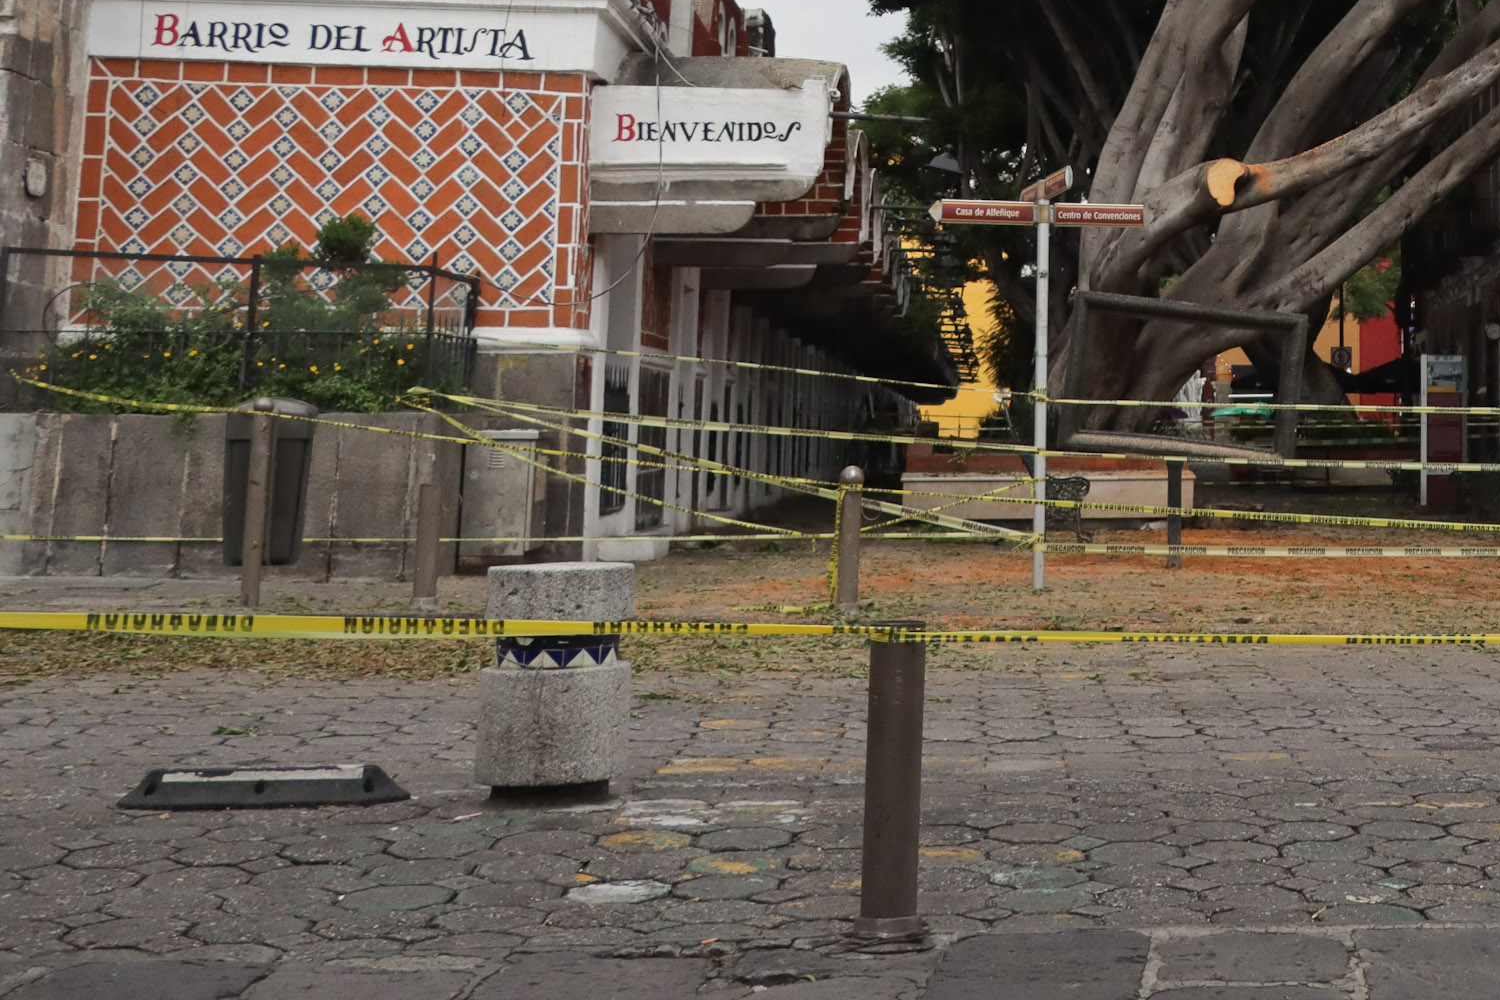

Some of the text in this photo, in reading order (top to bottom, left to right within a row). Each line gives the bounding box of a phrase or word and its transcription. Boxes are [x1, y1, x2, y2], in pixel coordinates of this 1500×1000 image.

[308, 23, 372, 52] DEL
[955, 206, 1020, 219] Casa de Alfeñique
[1057, 210, 1141, 222] Centro de Convenciones
[1046, 545, 1085, 553] PRECAUCION
[1106, 545, 1145, 554] PRECAUCION
[1168, 546, 1207, 555] PRECAUCION
[1227, 547, 1265, 556] PRECAUCION
[1287, 548, 1325, 556] PRECAUCION
[1345, 548, 1383, 556] PRECAUCION
